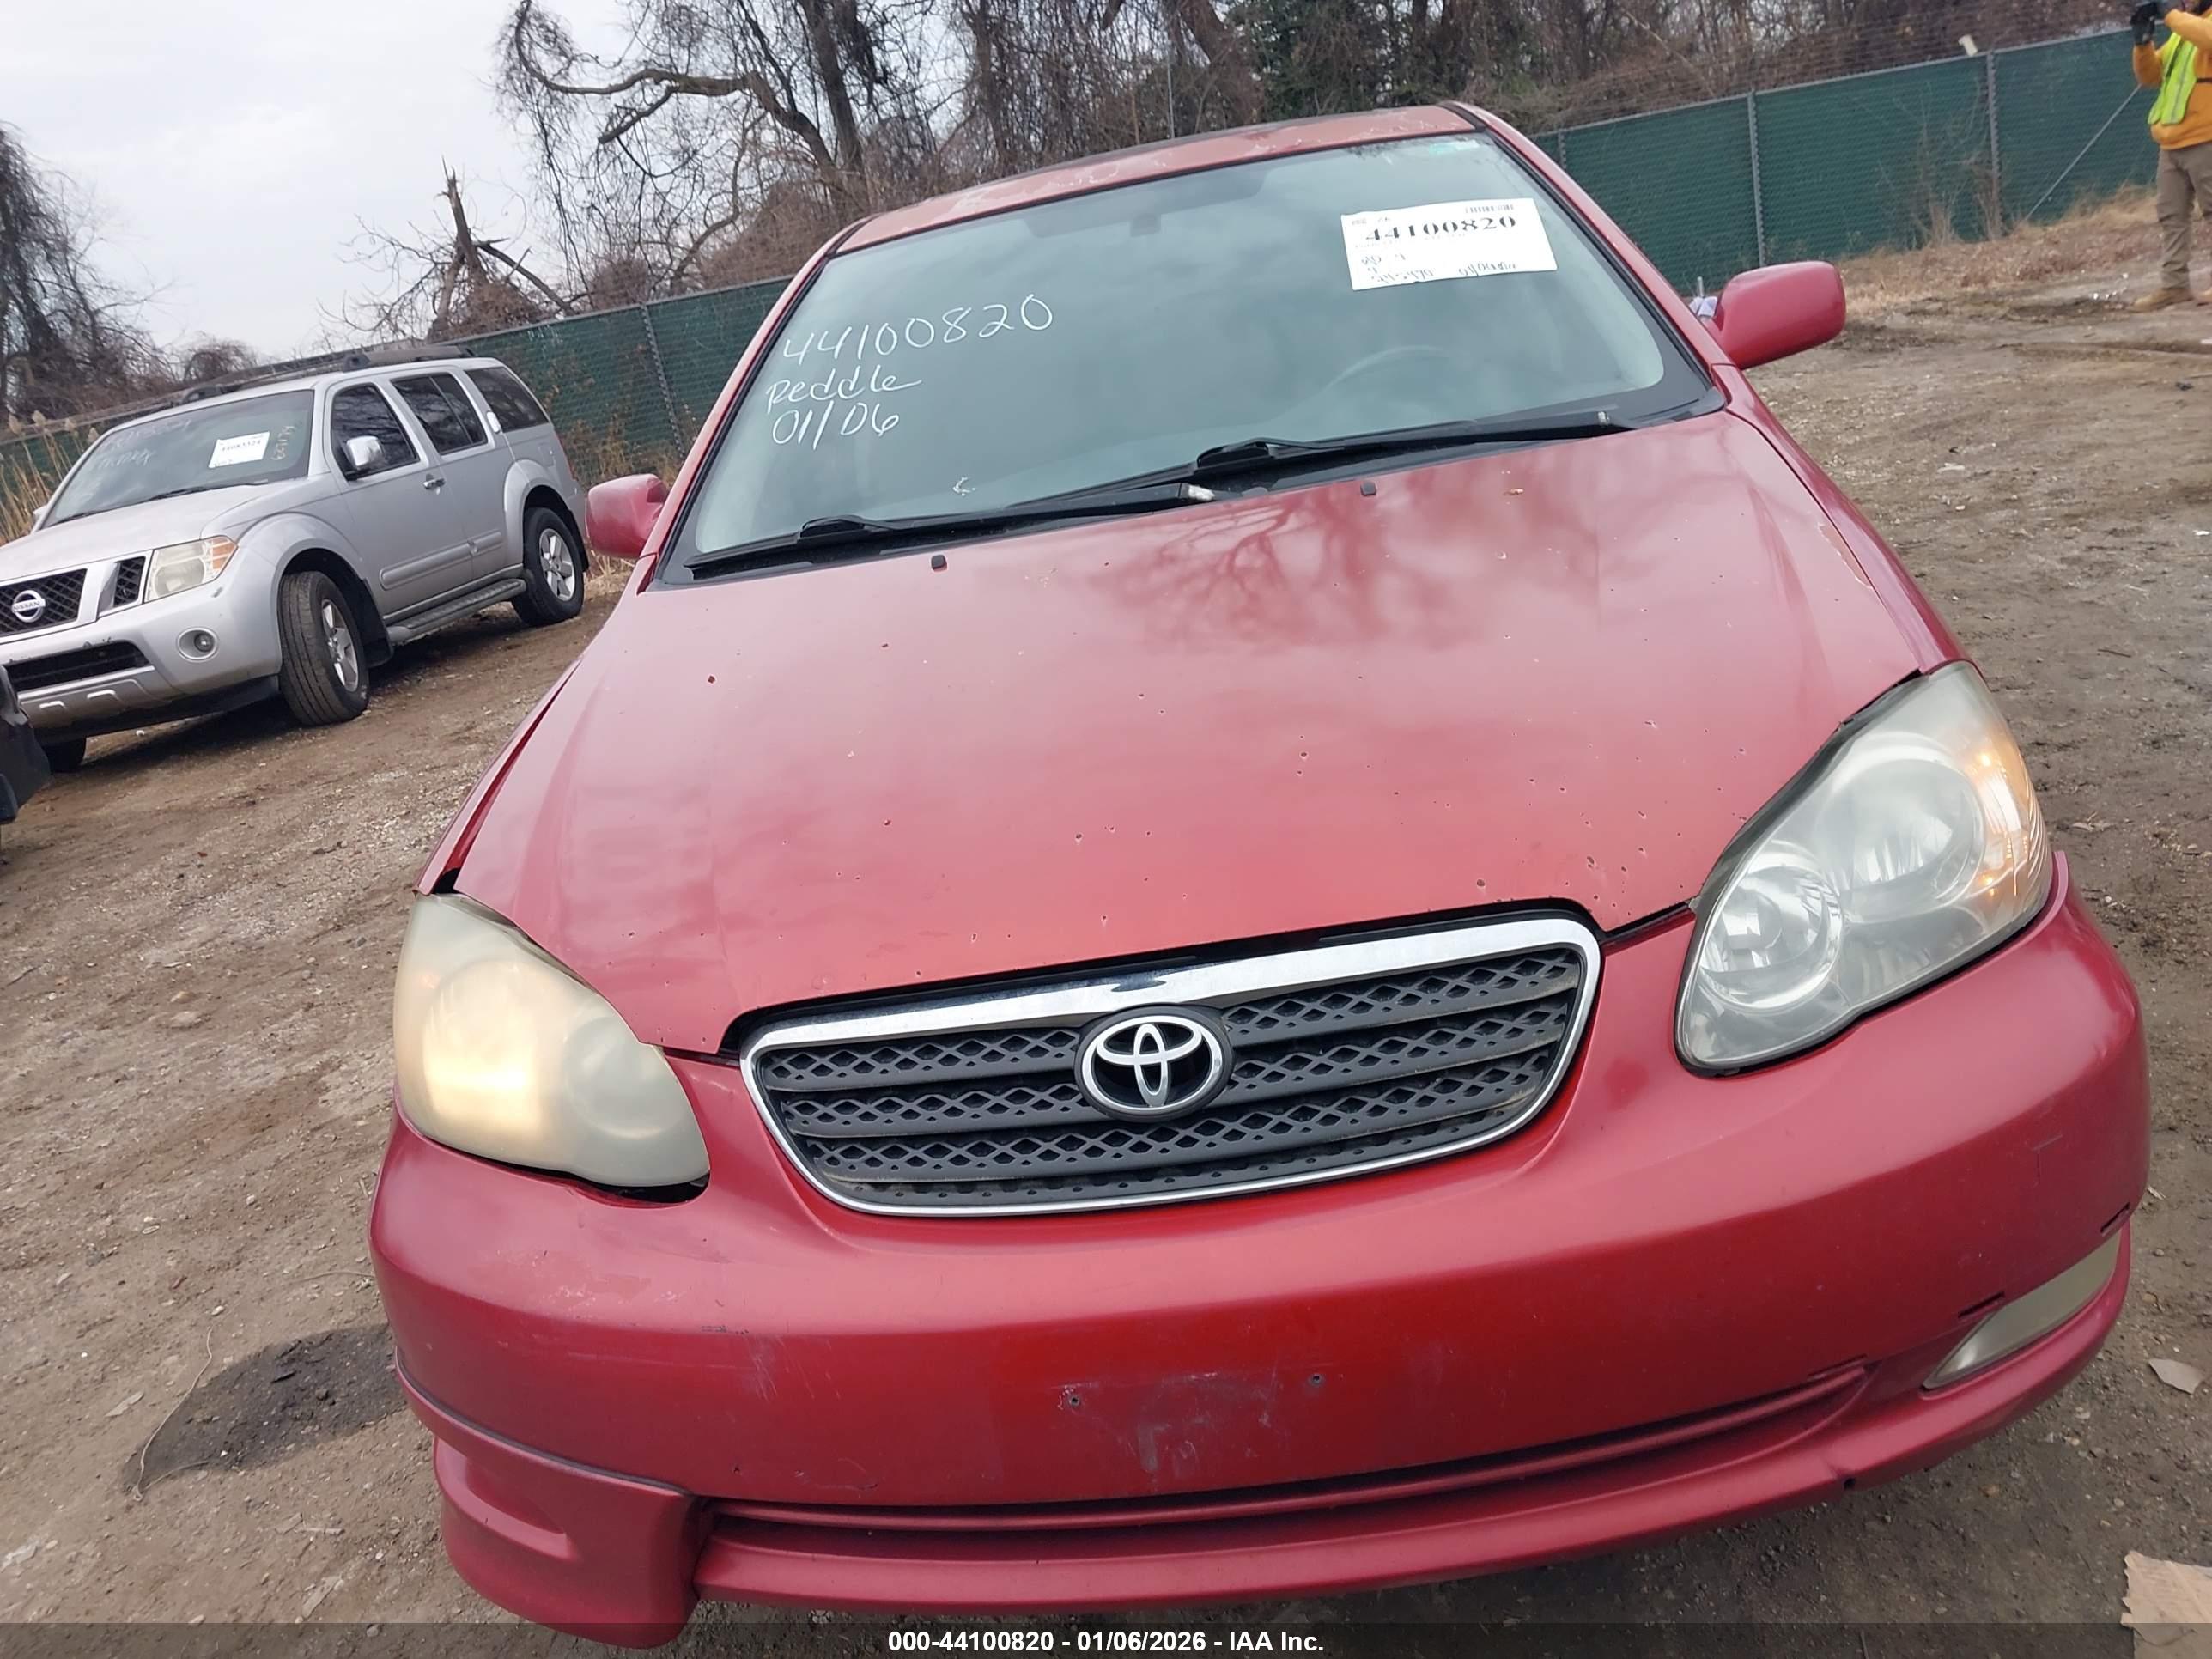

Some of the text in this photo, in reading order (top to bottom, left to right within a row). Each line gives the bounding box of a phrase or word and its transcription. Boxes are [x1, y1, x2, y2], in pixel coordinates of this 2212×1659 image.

[1366, 216, 1516, 240] 44100820
[781, 293, 1054, 366] 44100820
[772, 399, 900, 451] 01/06
[14, 601, 40, 611] NISSAN
